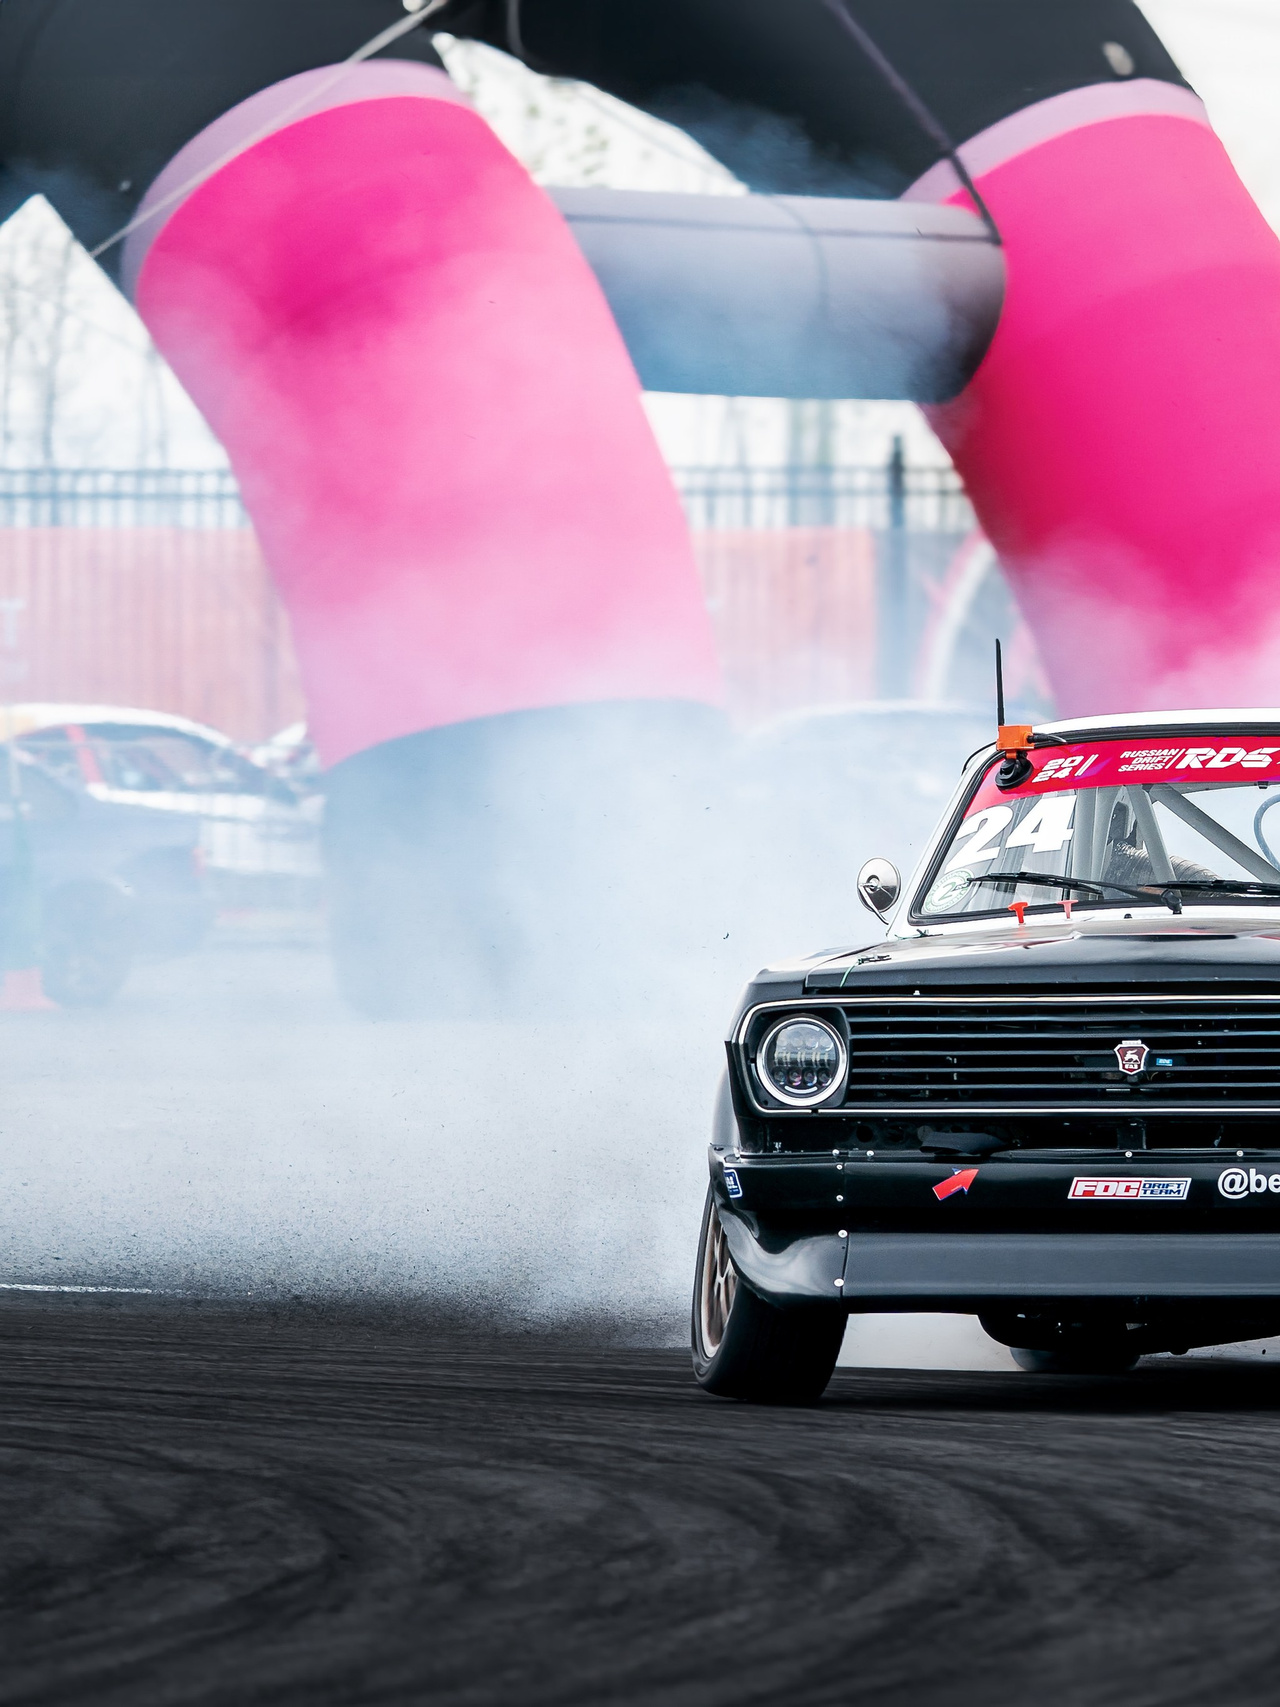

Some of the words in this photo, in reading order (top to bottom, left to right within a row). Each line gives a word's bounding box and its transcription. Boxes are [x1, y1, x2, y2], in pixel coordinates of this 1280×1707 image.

[1120, 748, 1179, 759] RUSSIAN
[1131, 755, 1173, 765] DRIFT
[1042, 755, 1084, 771] 20
[1118, 763, 1165, 772] SERIES
[1032, 767, 1073, 783] 24
[942, 795, 1078, 872] 24
[1073, 1181, 1141, 1196] FDC
